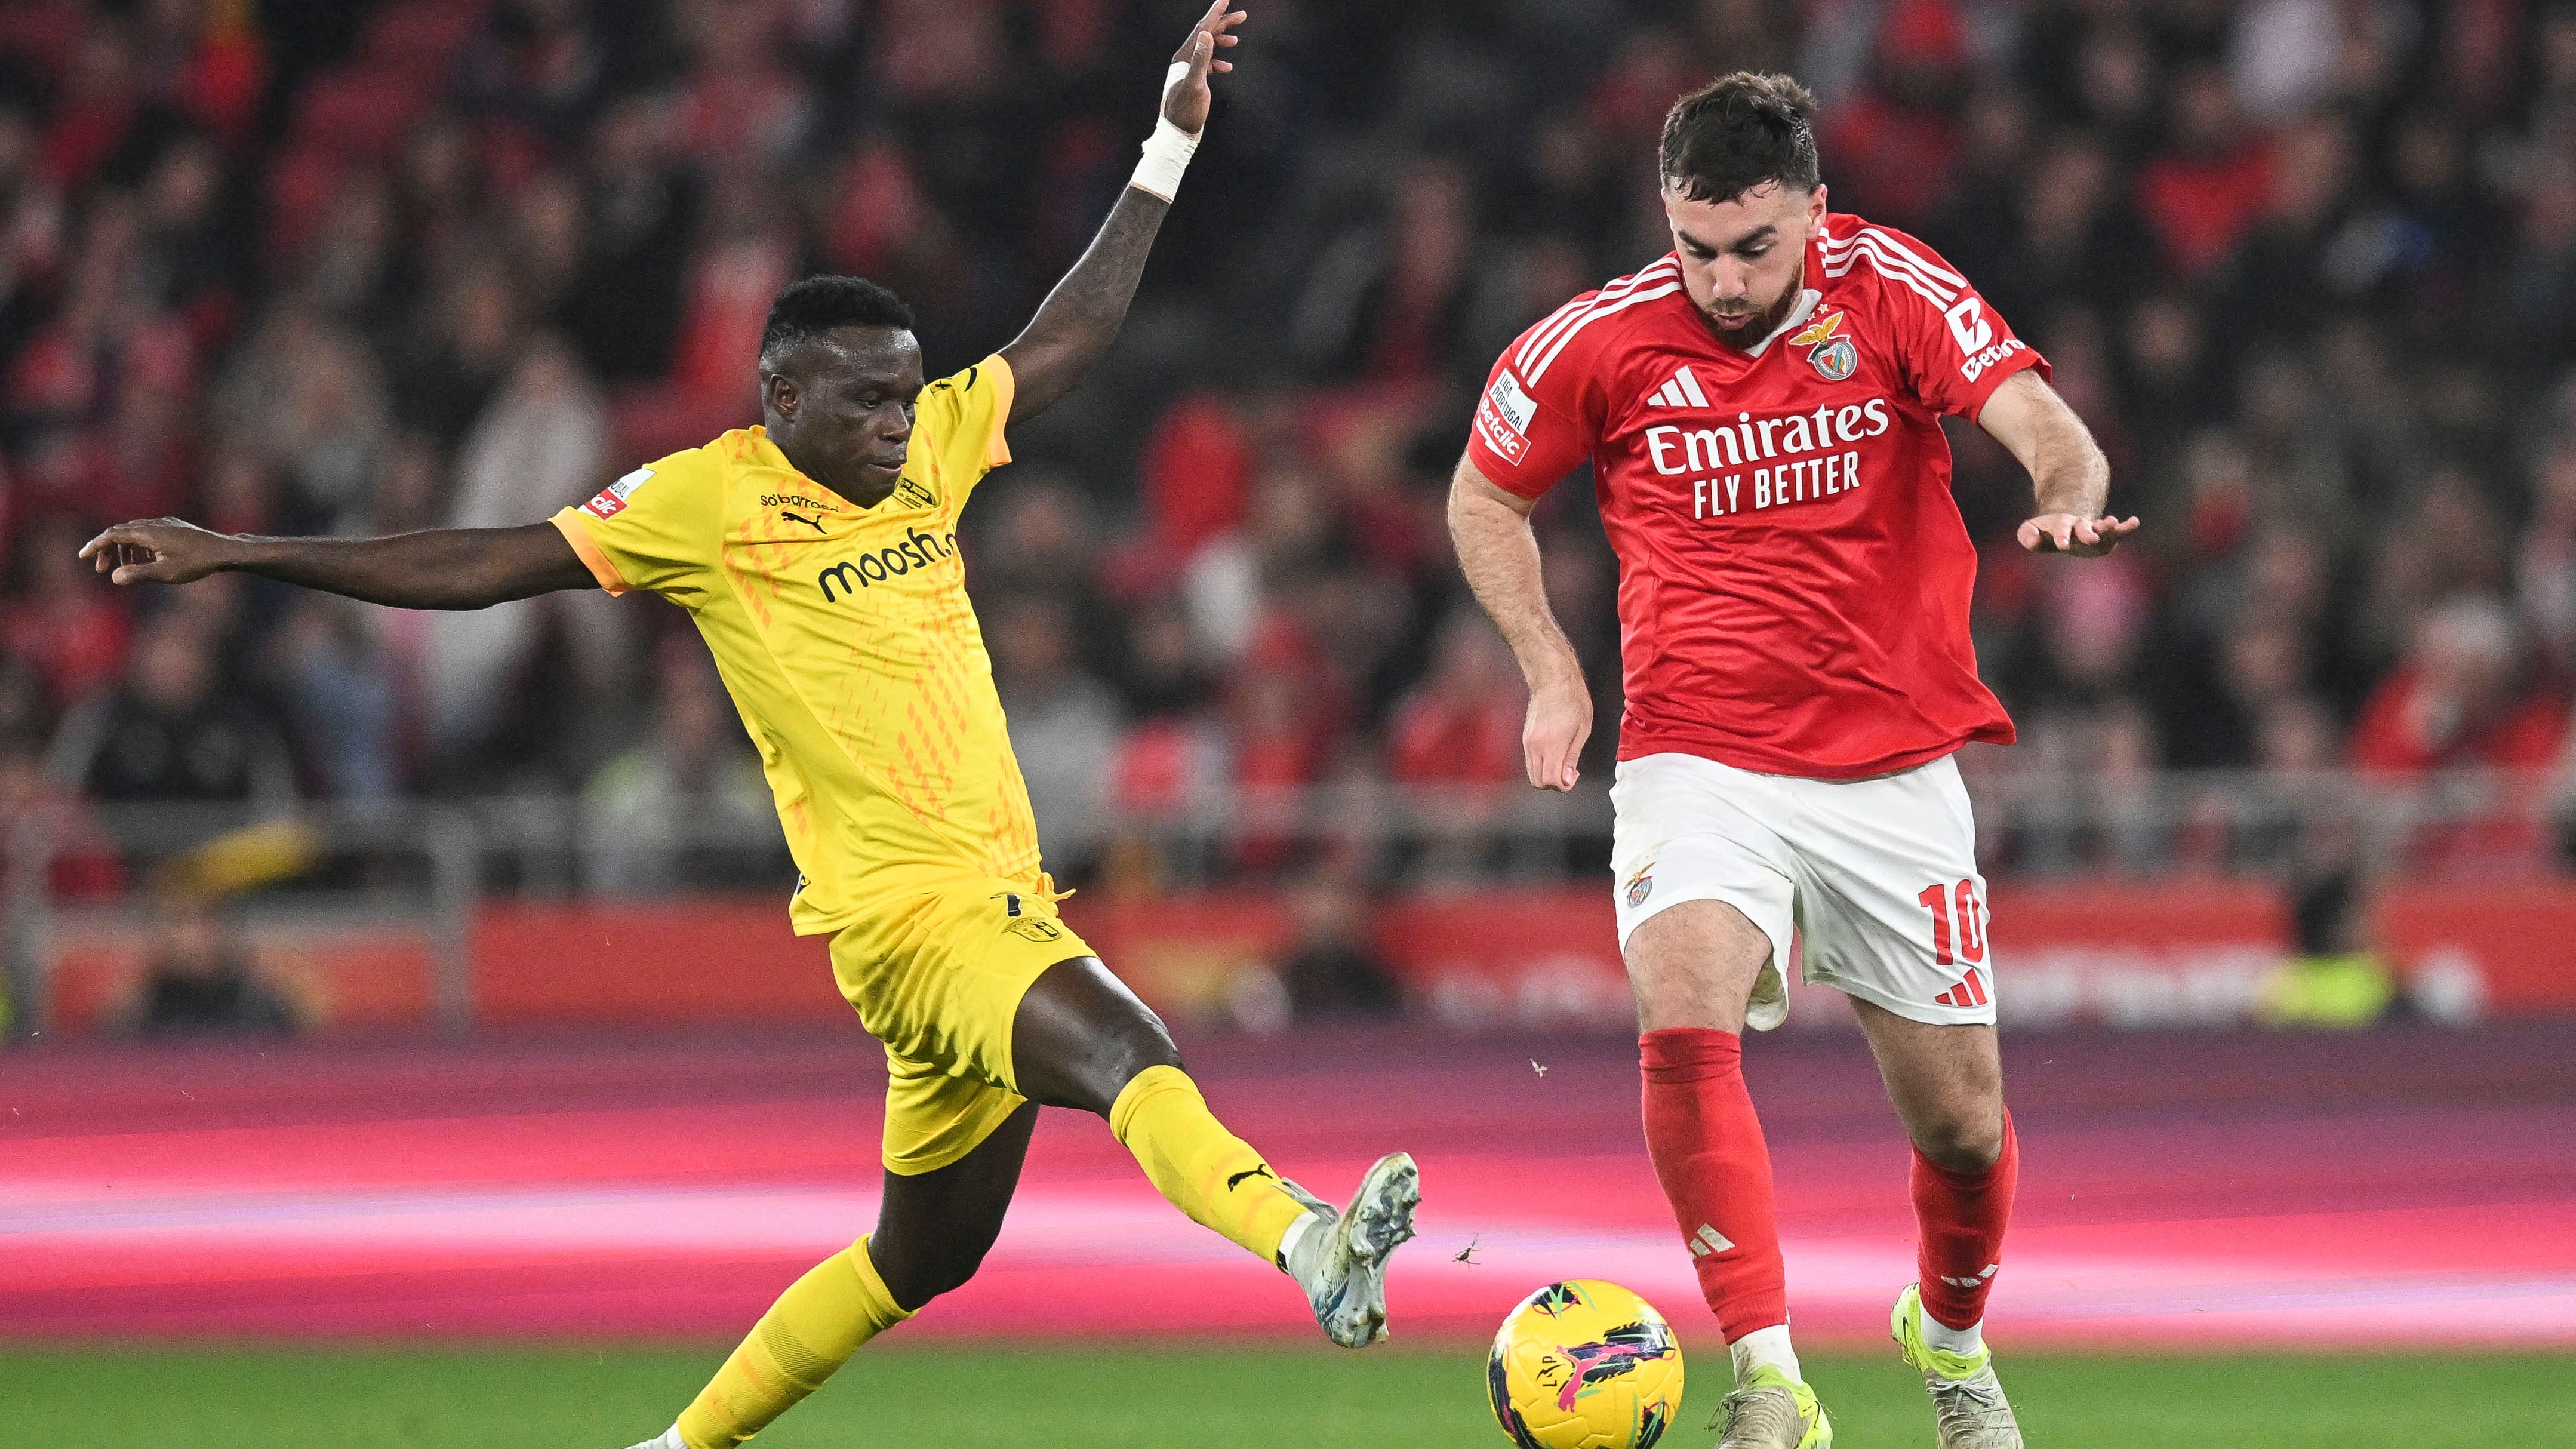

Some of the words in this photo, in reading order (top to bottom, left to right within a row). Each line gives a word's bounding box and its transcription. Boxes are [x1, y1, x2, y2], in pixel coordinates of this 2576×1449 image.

[1500, 373, 1513, 398] LIGA
[1960, 339, 2026, 383] Betn
[1481, 396, 1520, 456] Betclic
[1492, 385, 1524, 432] PORTUGAL
[1645, 398, 1889, 475] Emirates
[590, 494, 617, 514] clic
[1694, 474, 1740, 519] FLY
[1754, 451, 1861, 509] BETTER
[1918, 879, 1983, 965] 10
